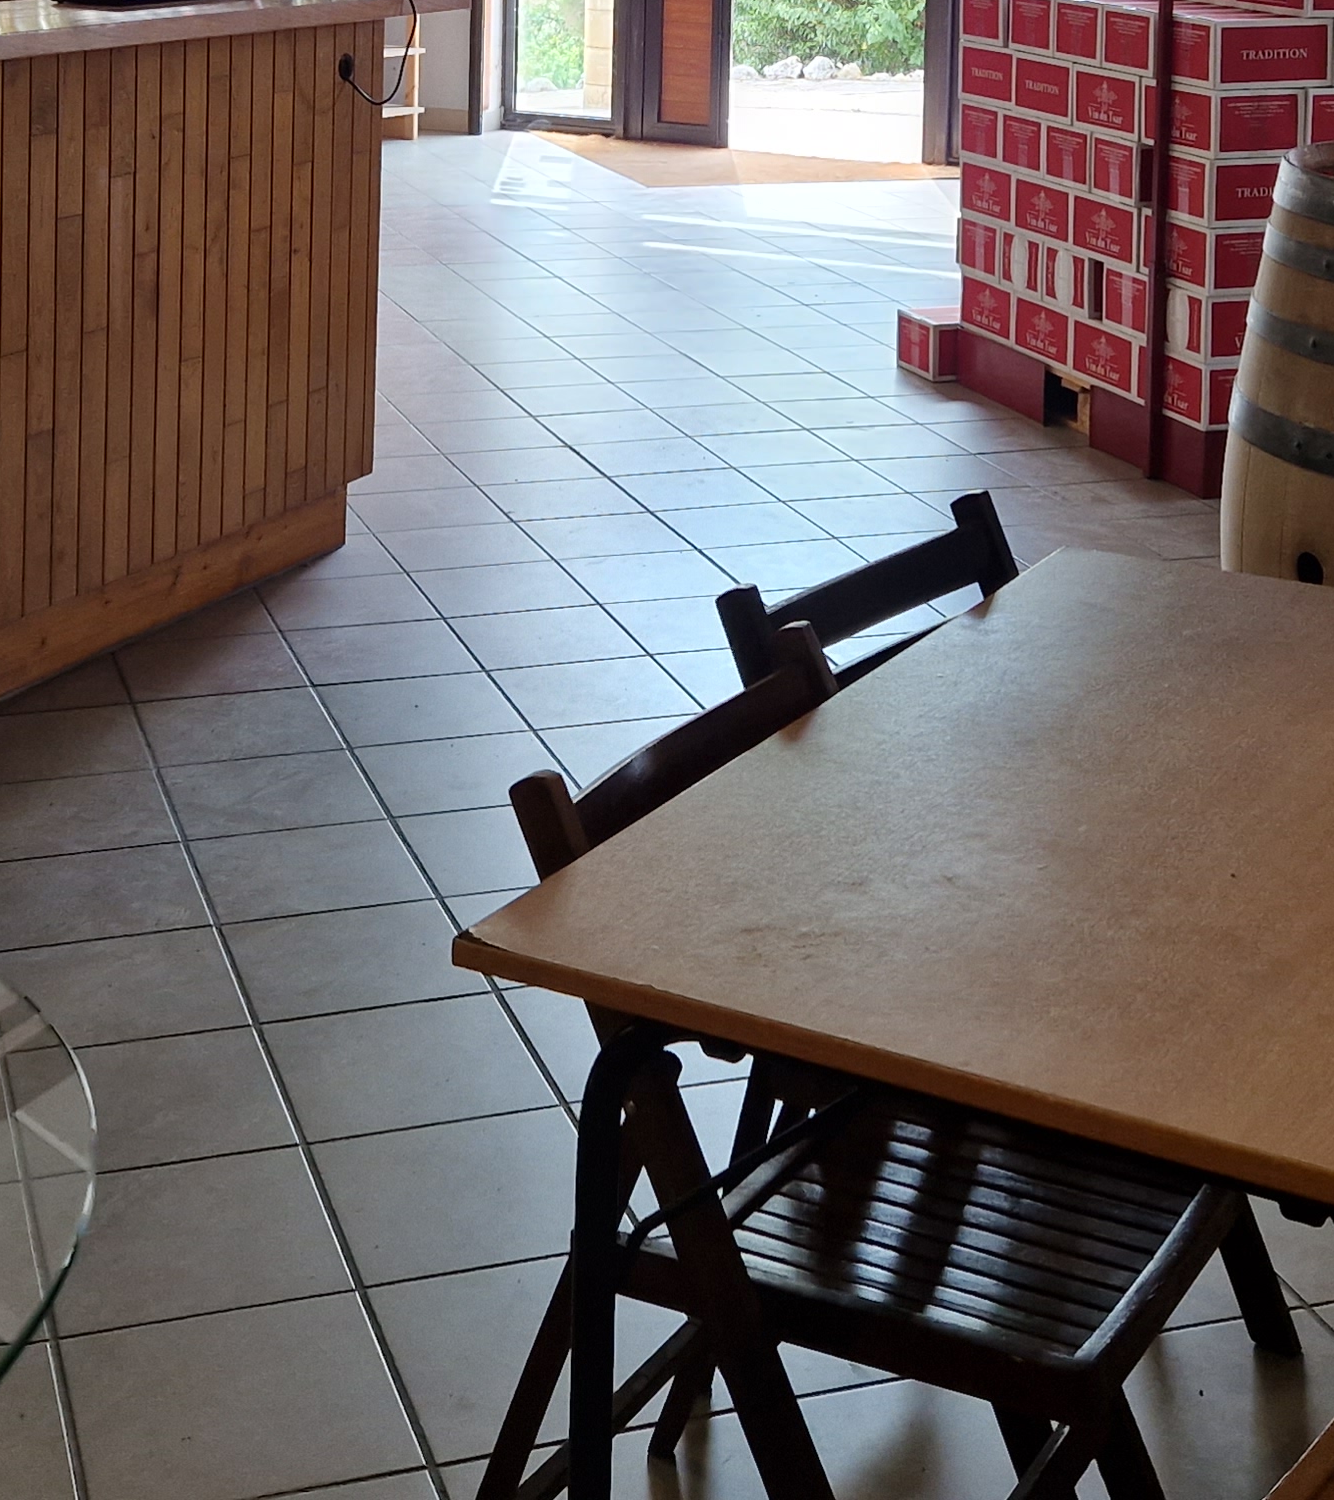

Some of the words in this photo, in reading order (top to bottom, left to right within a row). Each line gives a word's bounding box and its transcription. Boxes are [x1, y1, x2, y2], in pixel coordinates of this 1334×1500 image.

[1241, 48, 1308, 61] TRADITION
[971, 67, 1003, 81] TRADITION
[1025, 79, 1060, 96] TRADITION
[1087, 105, 1099, 120] Vin
[1108, 110, 1124, 125] Tsar
[1181, 127, 1198, 142] Tsar
[1235, 186, 1273, 199] TRADI
[1085, 230, 1098, 246] Vin
[1106, 238, 1121, 253] Tsar
[1085, 356, 1096, 372] Vin
[1105, 365, 1120, 381] Tsar
